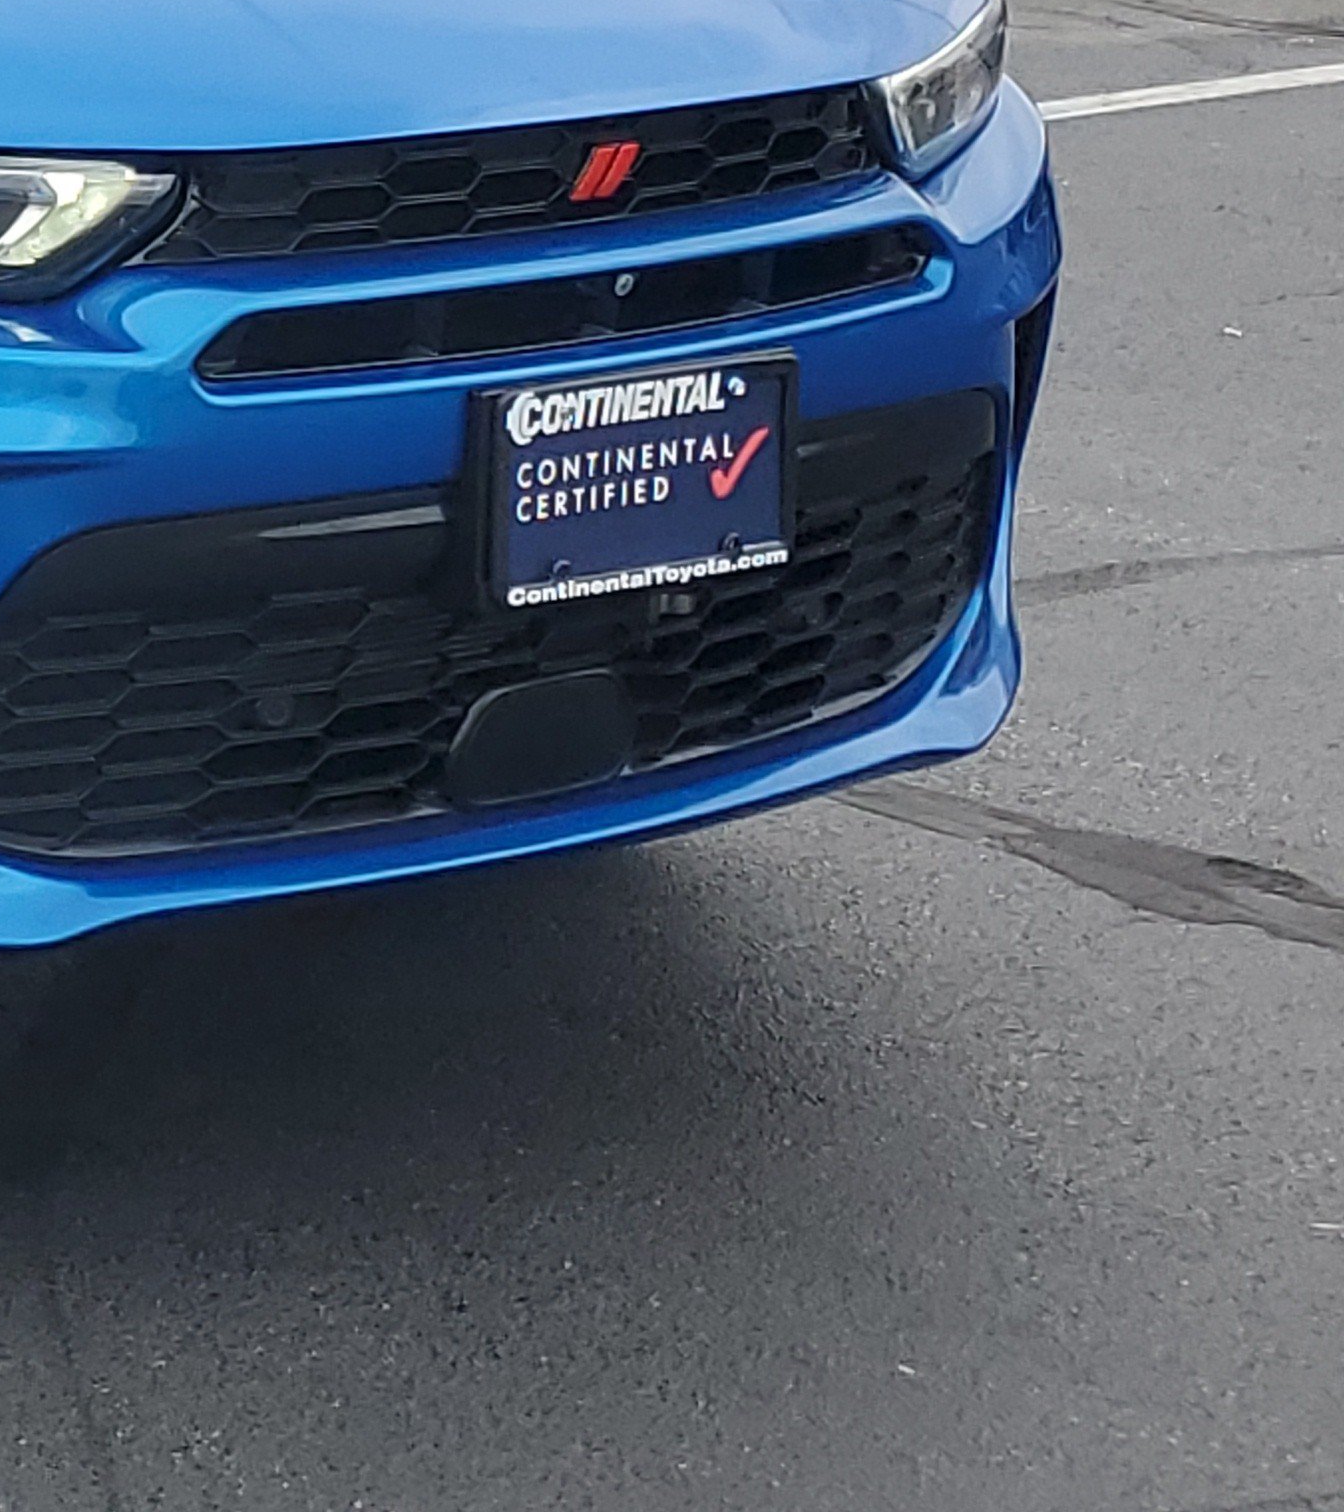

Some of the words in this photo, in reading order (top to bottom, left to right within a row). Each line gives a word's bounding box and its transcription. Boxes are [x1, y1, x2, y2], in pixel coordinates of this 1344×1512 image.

[507, 372, 725, 446] CONTINENTAL
[516, 434, 734, 489] CONTINENTAL
[516, 477, 670, 524] CERTIFIED
[507, 549, 789, 607] ContinentalToyota.com
